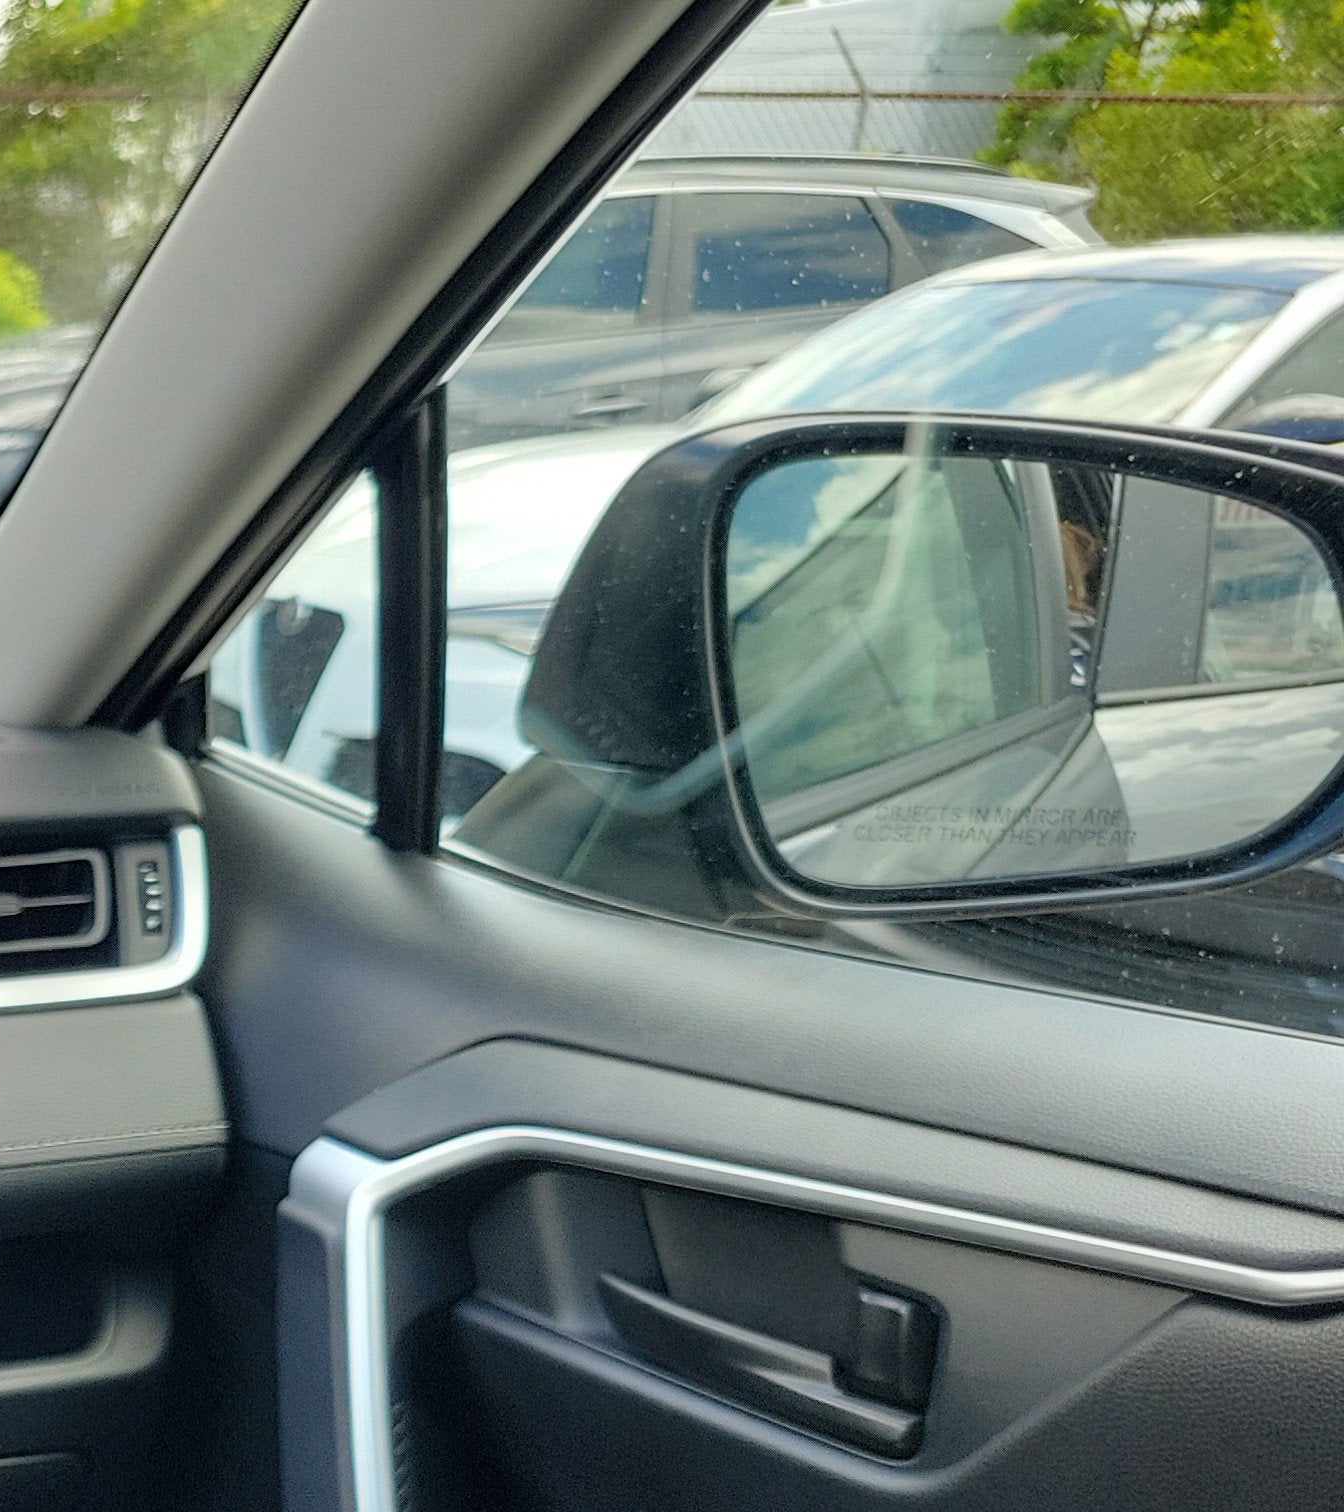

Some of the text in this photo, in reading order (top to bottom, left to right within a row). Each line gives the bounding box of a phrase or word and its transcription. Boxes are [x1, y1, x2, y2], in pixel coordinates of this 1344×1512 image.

[994, 807, 1076, 826] MRROR
[853, 825, 932, 843] CLOSER
[1002, 827, 1050, 846] HEY
